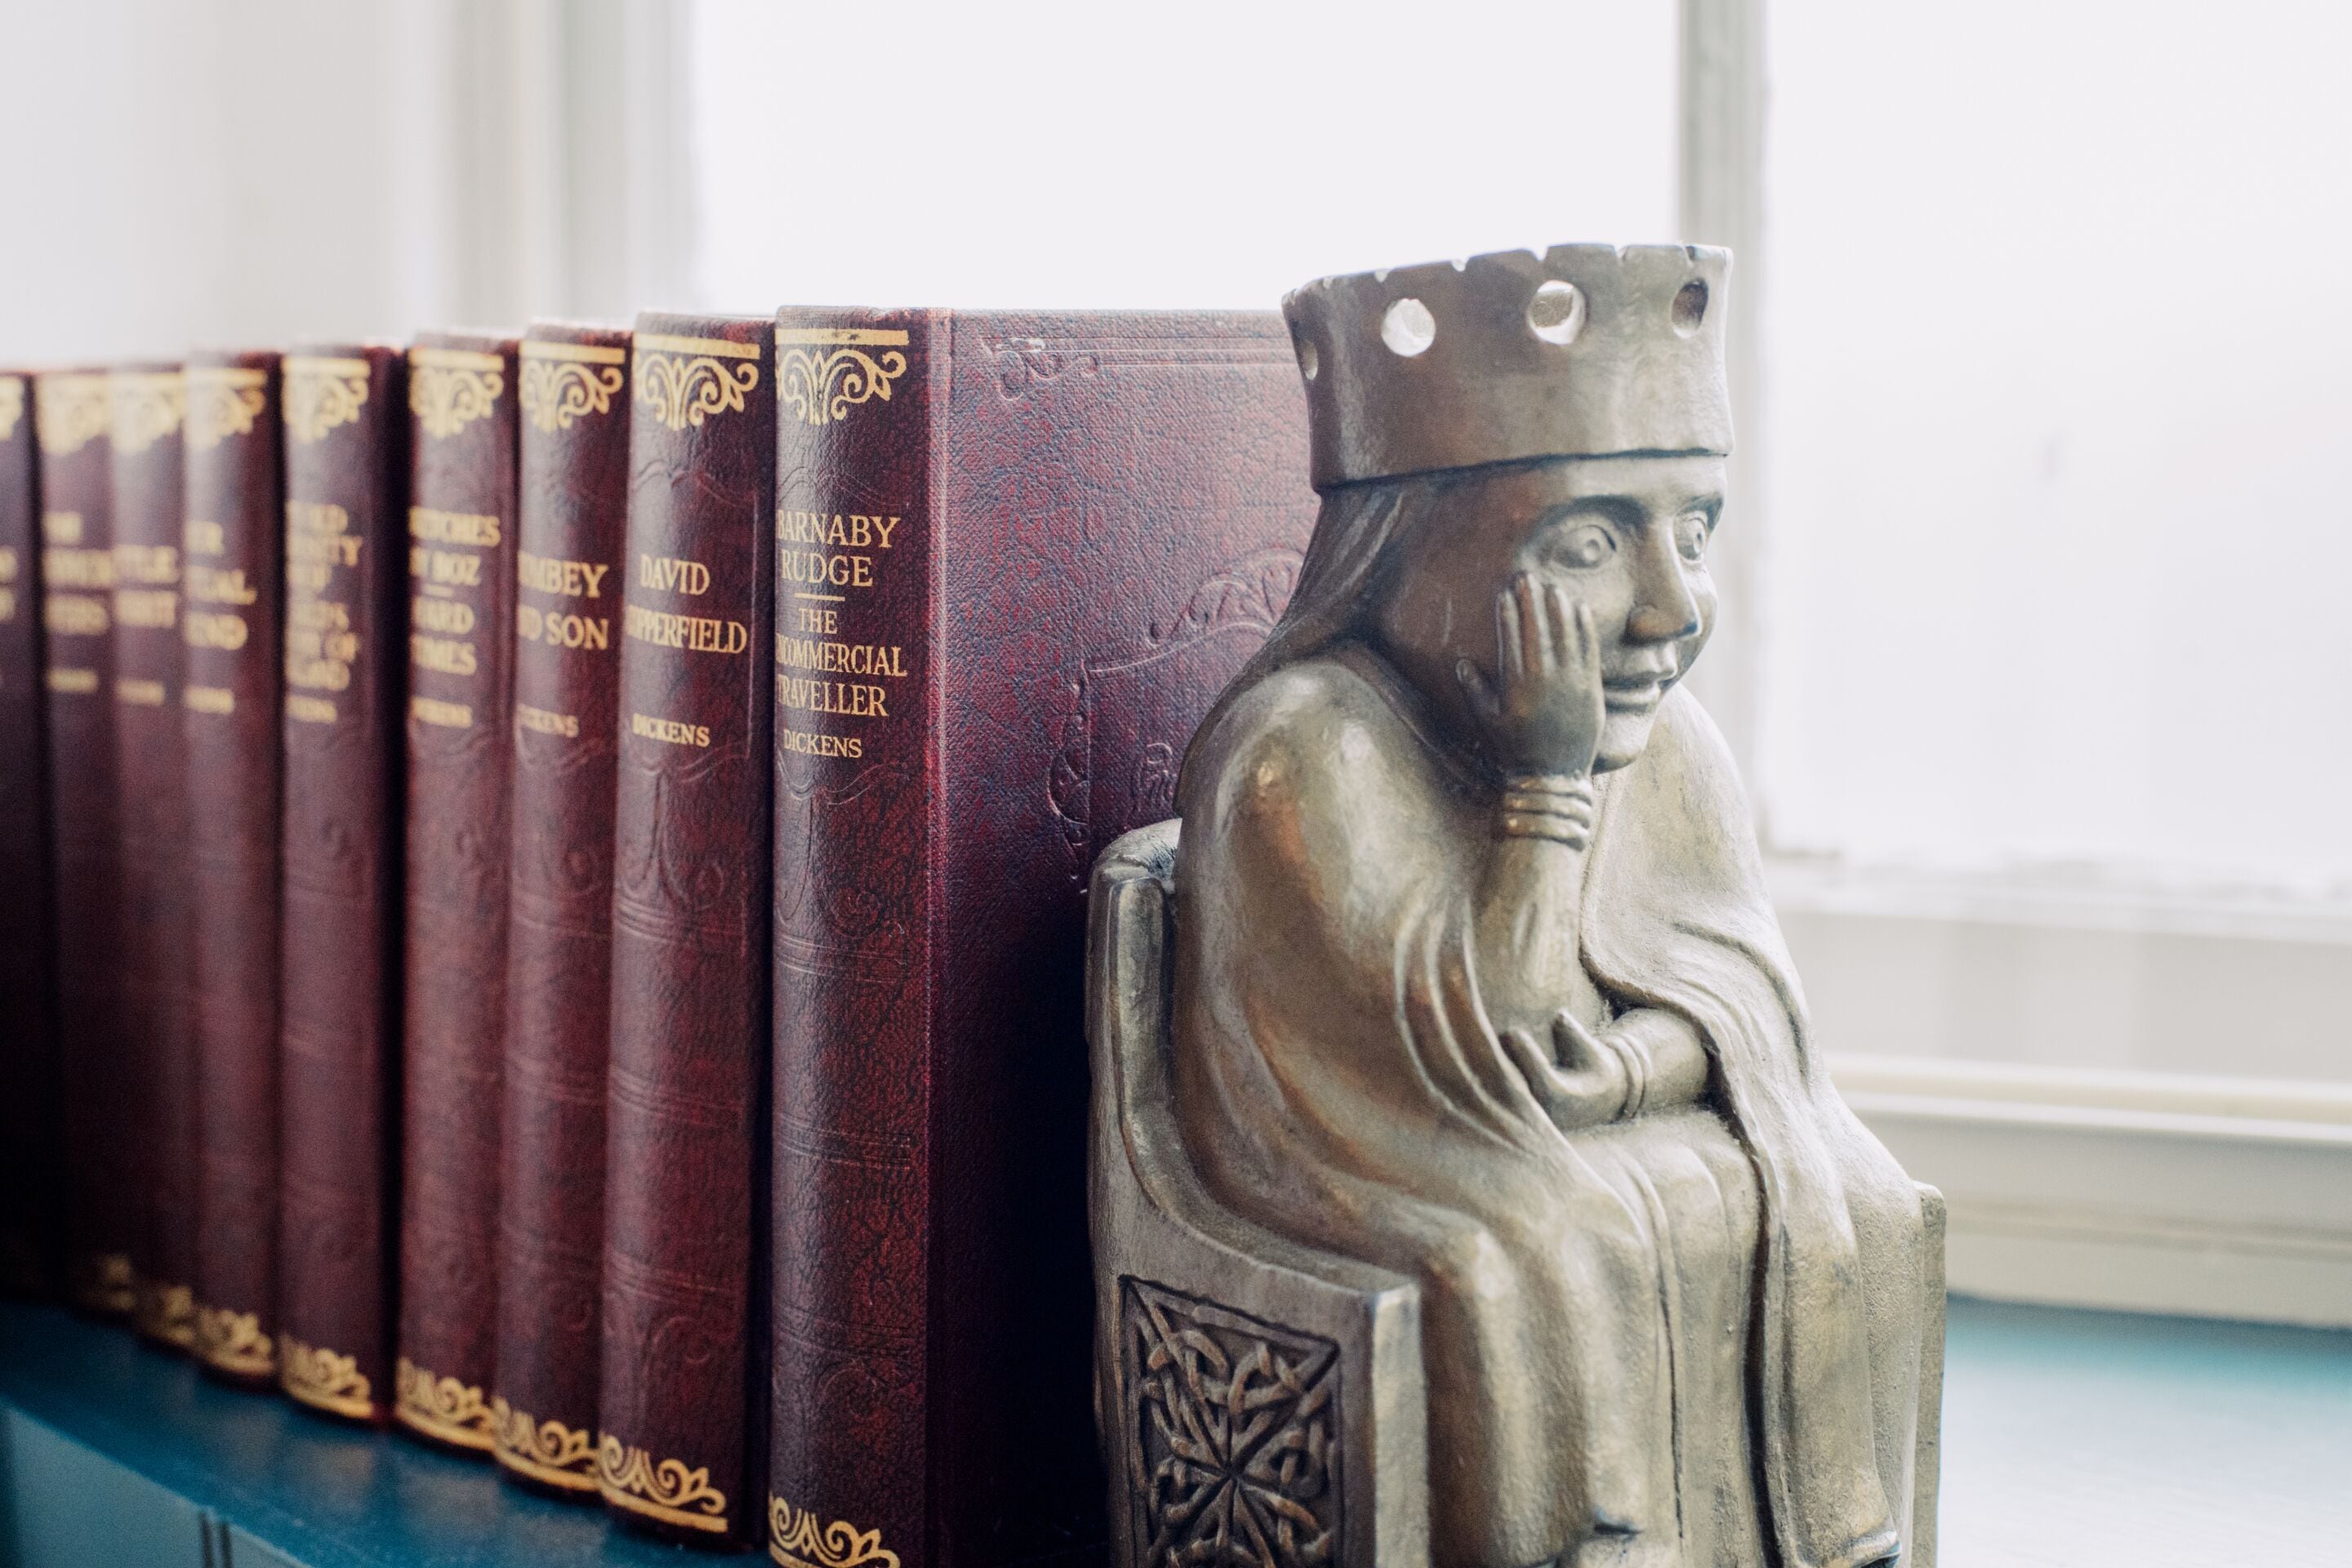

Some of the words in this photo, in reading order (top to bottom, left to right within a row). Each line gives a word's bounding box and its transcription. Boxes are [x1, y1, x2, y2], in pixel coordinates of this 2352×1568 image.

[777, 509, 901, 548] BARNABY
[640, 554, 710, 595] DAVID
[781, 549, 873, 587] RUDGE
[546, 612, 609, 650] SON
[798, 608, 838, 634] THE
[777, 674, 889, 716] TRAVELLER
[632, 712, 710, 747] DICKENS
[783, 728, 862, 758] DICKENS
